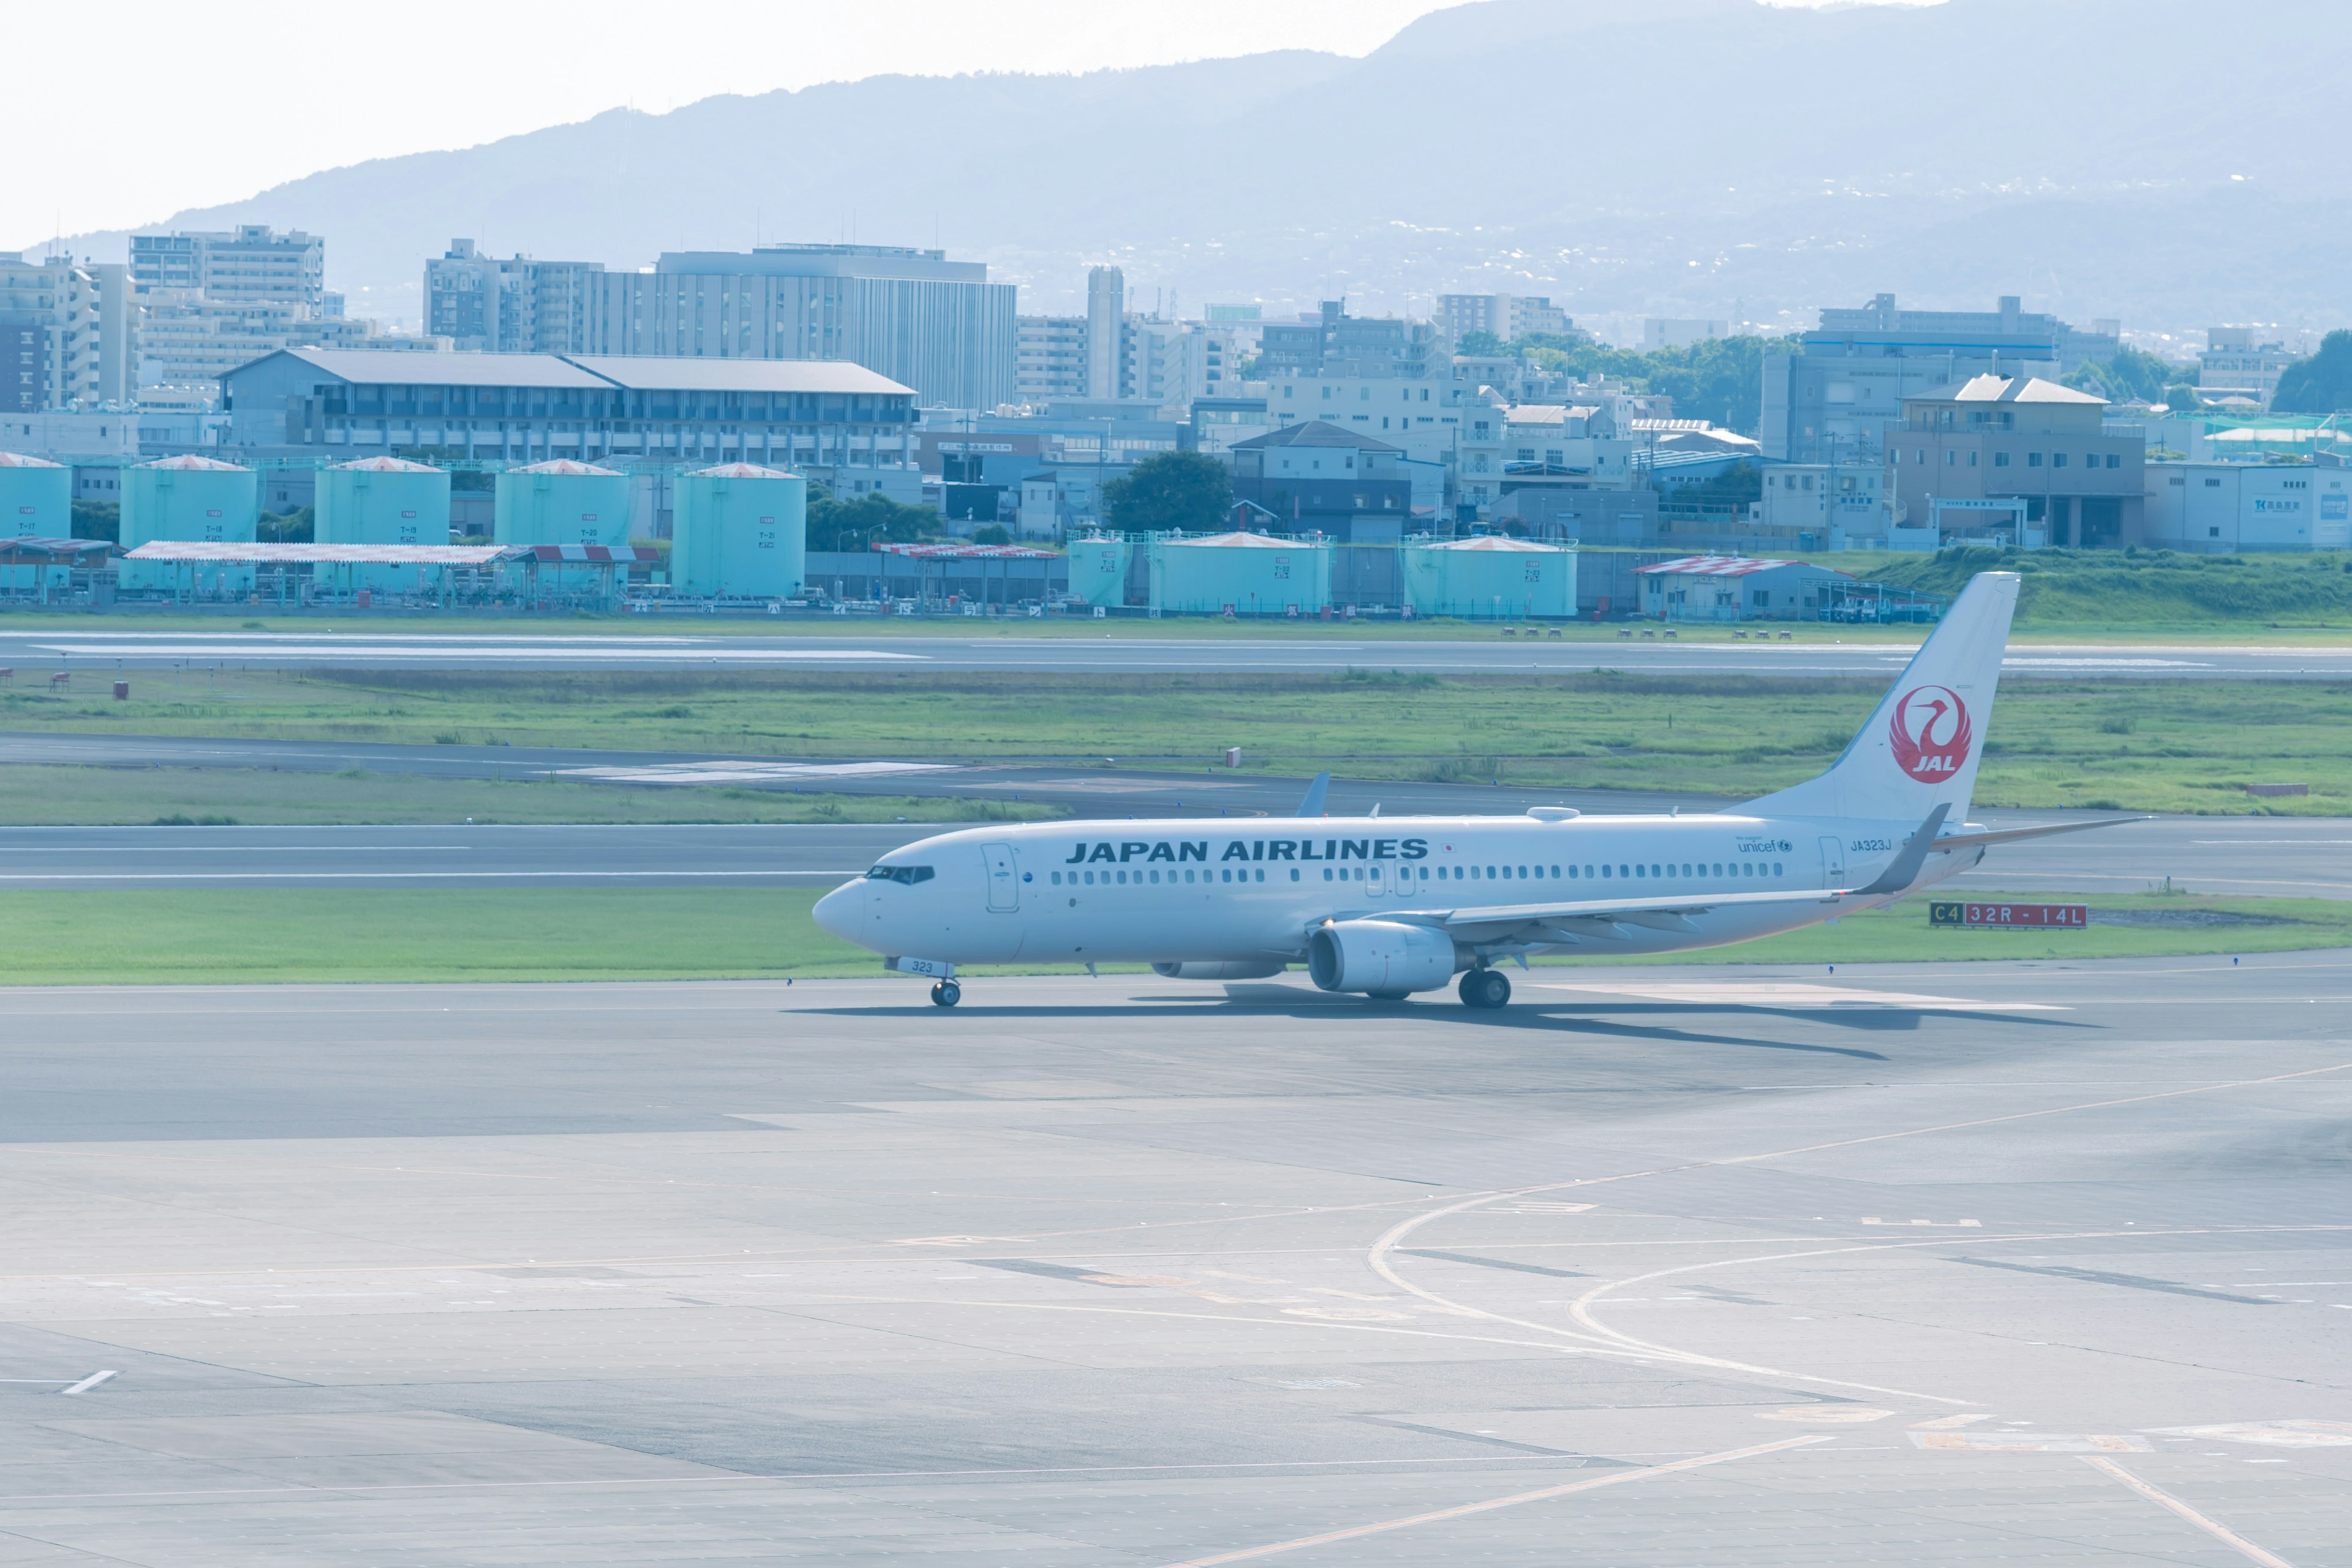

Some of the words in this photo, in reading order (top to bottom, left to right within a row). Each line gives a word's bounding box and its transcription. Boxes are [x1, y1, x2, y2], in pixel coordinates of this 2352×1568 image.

[1912, 756, 1956, 772] JAL
[1065, 842, 1208, 863] JAPAN
[1220, 839, 1428, 861] AIRLINES
[1738, 839, 1777, 852] unicef
[1851, 839, 1892, 852] JA323J
[1935, 906, 1959, 921] C4
[1971, 907, 2011, 922] 32R
[2043, 908, 2082, 924] 14L
[912, 960, 933, 973] 323
